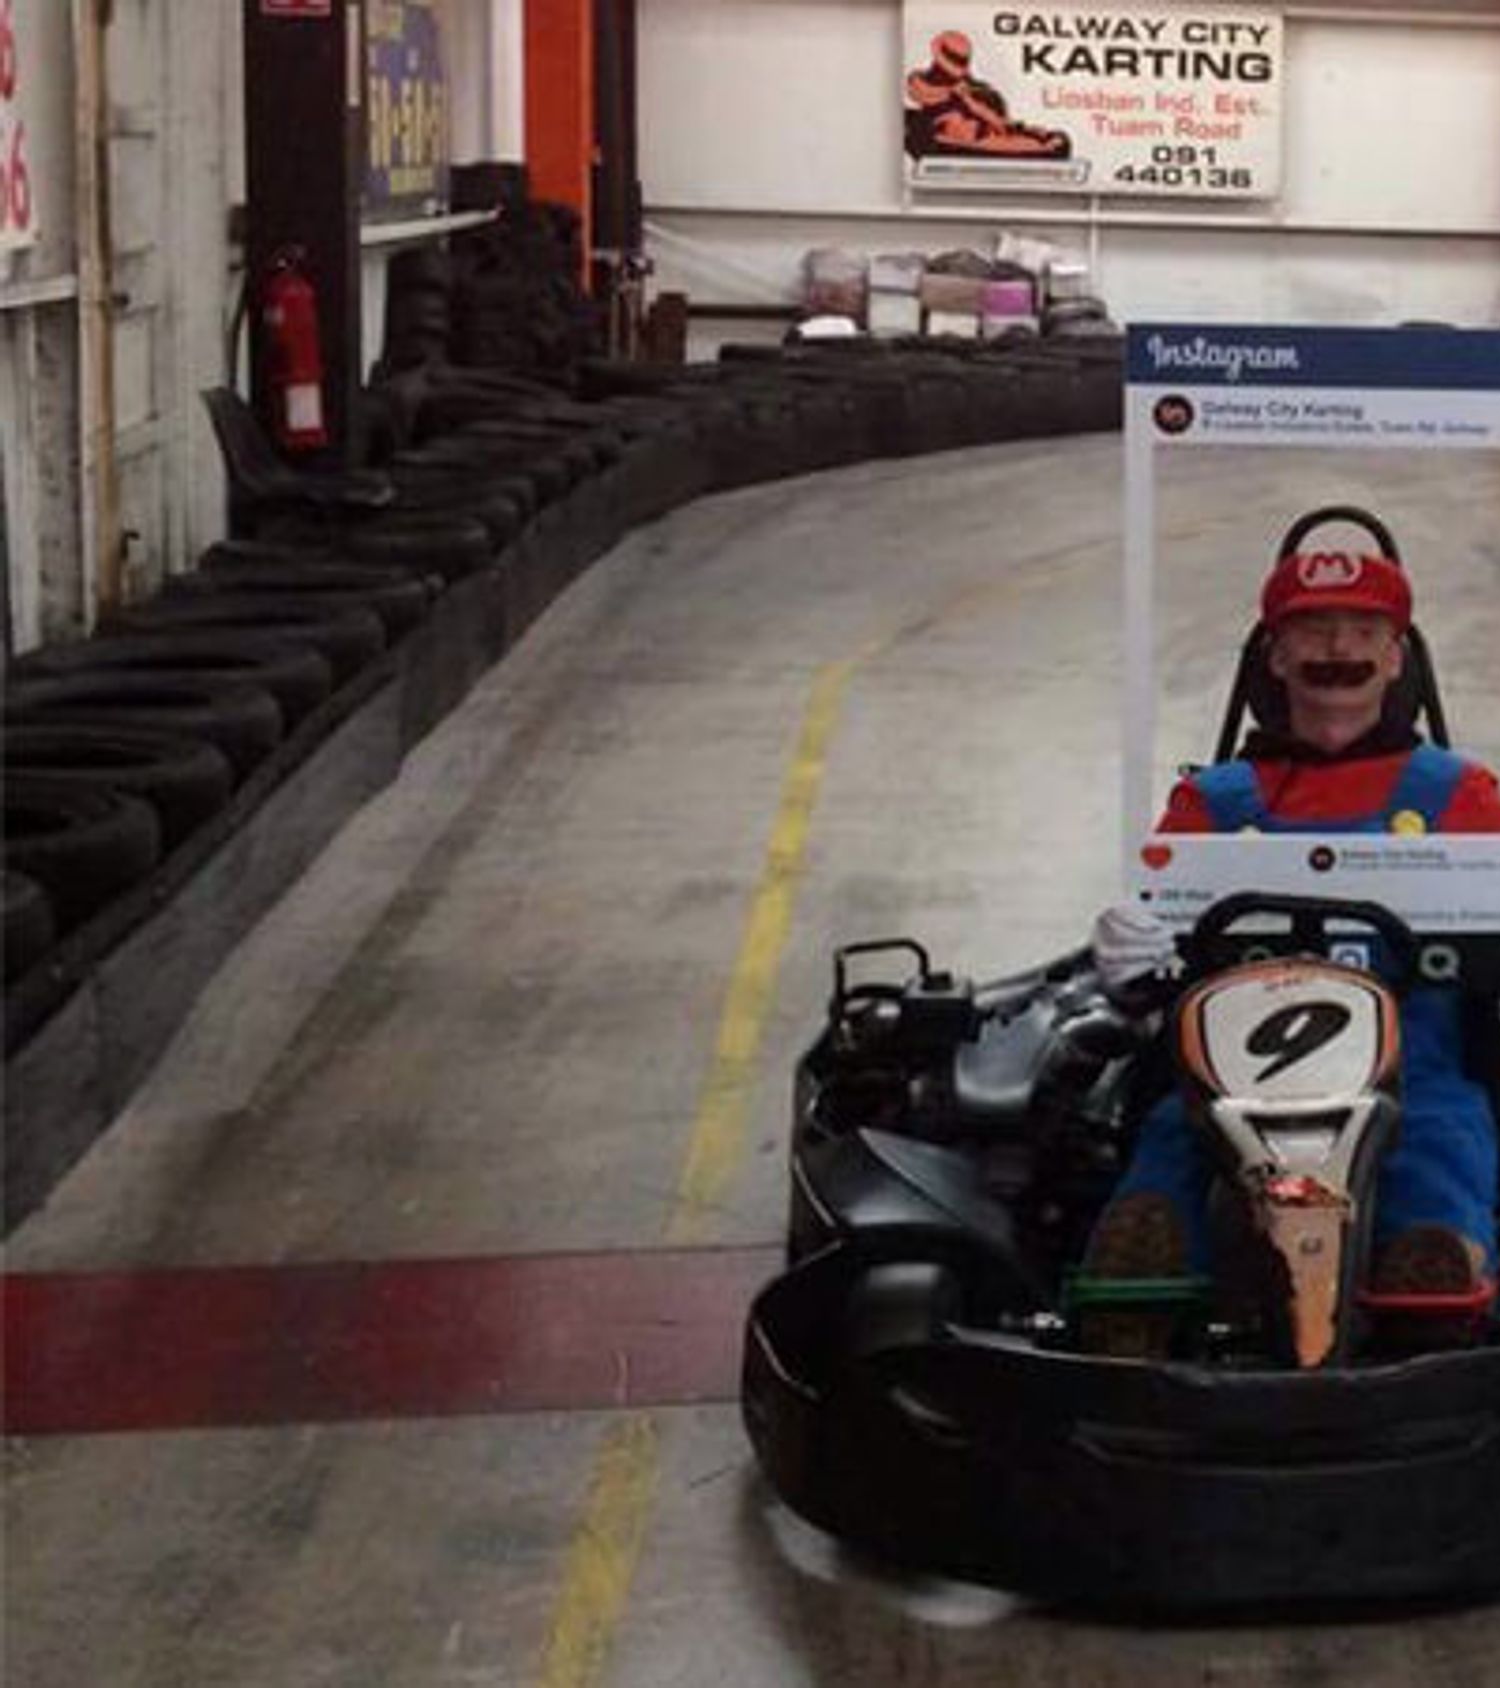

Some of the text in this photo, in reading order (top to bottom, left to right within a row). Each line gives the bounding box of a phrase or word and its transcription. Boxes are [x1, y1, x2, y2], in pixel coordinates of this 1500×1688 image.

[993, 13, 1270, 45] GALWAY CITY
[1022, 45, 1272, 82] KARTING
[1042, 88, 1144, 110] Liosban
[1090, 114, 1242, 139] Tuam Road
[1152, 146, 1216, 164] 091
[1114, 166, 1251, 188] 440136
[1147, 335, 1300, 380] Instagram
[1266, 401, 1299, 419] City
[1303, 550, 1356, 582] M
[1246, 1000, 1352, 1083] 9
